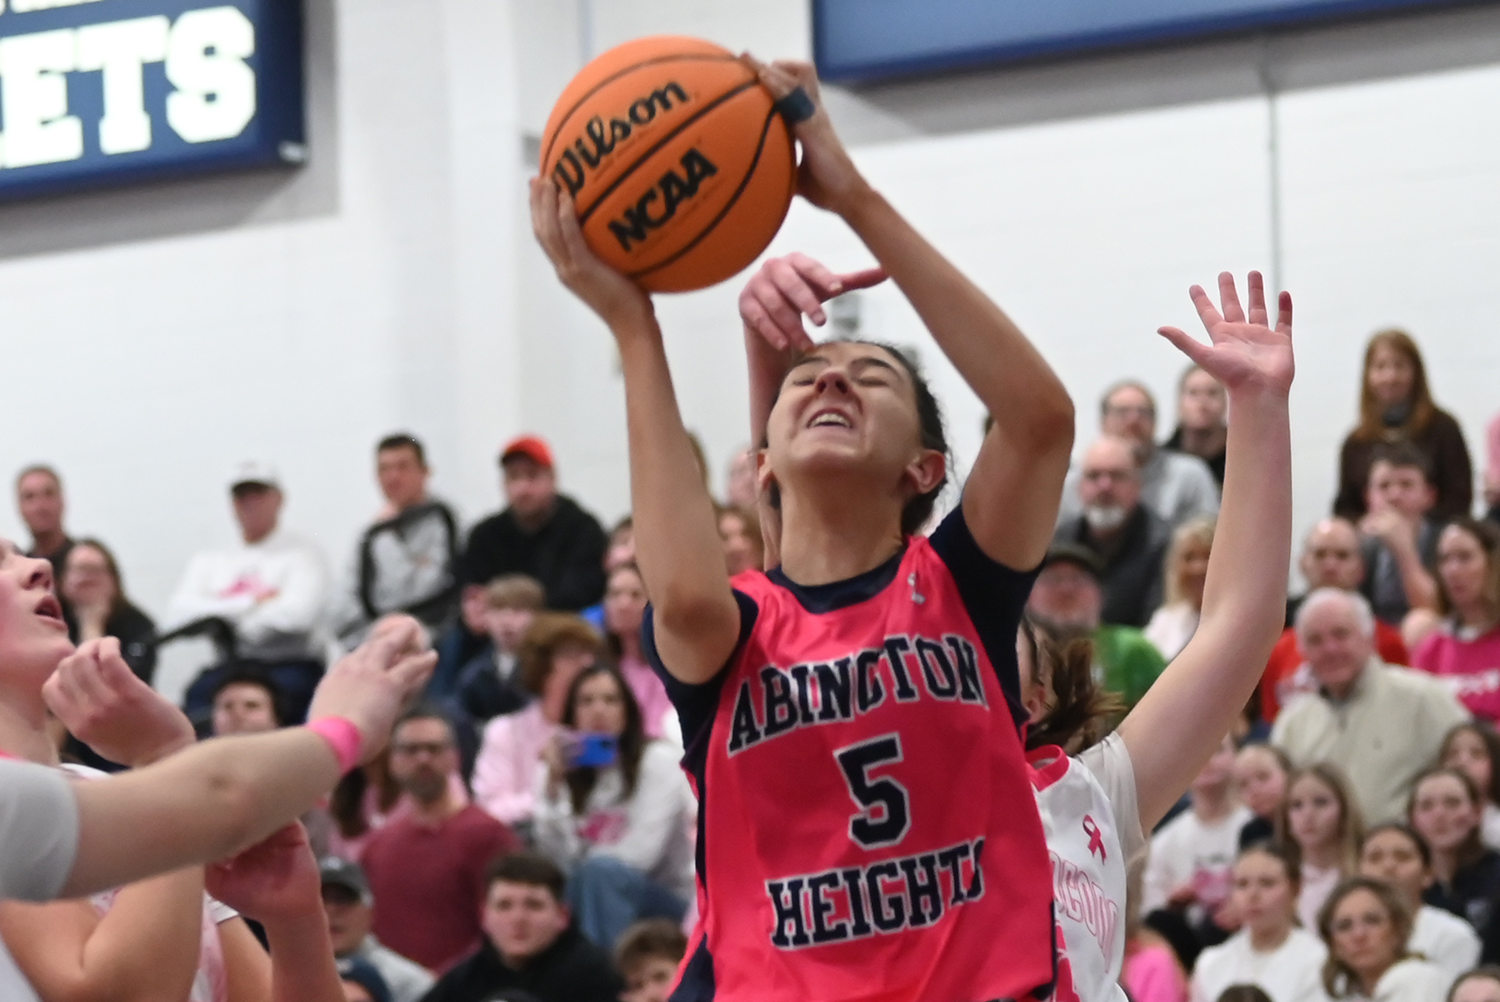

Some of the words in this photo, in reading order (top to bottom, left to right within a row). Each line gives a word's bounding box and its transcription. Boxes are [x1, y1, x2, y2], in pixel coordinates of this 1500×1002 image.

[553, 79, 691, 197] Wilson
[607, 147, 718, 251] NCAA
[727, 631, 989, 758] ABINGTON
[833, 732, 911, 850] 5
